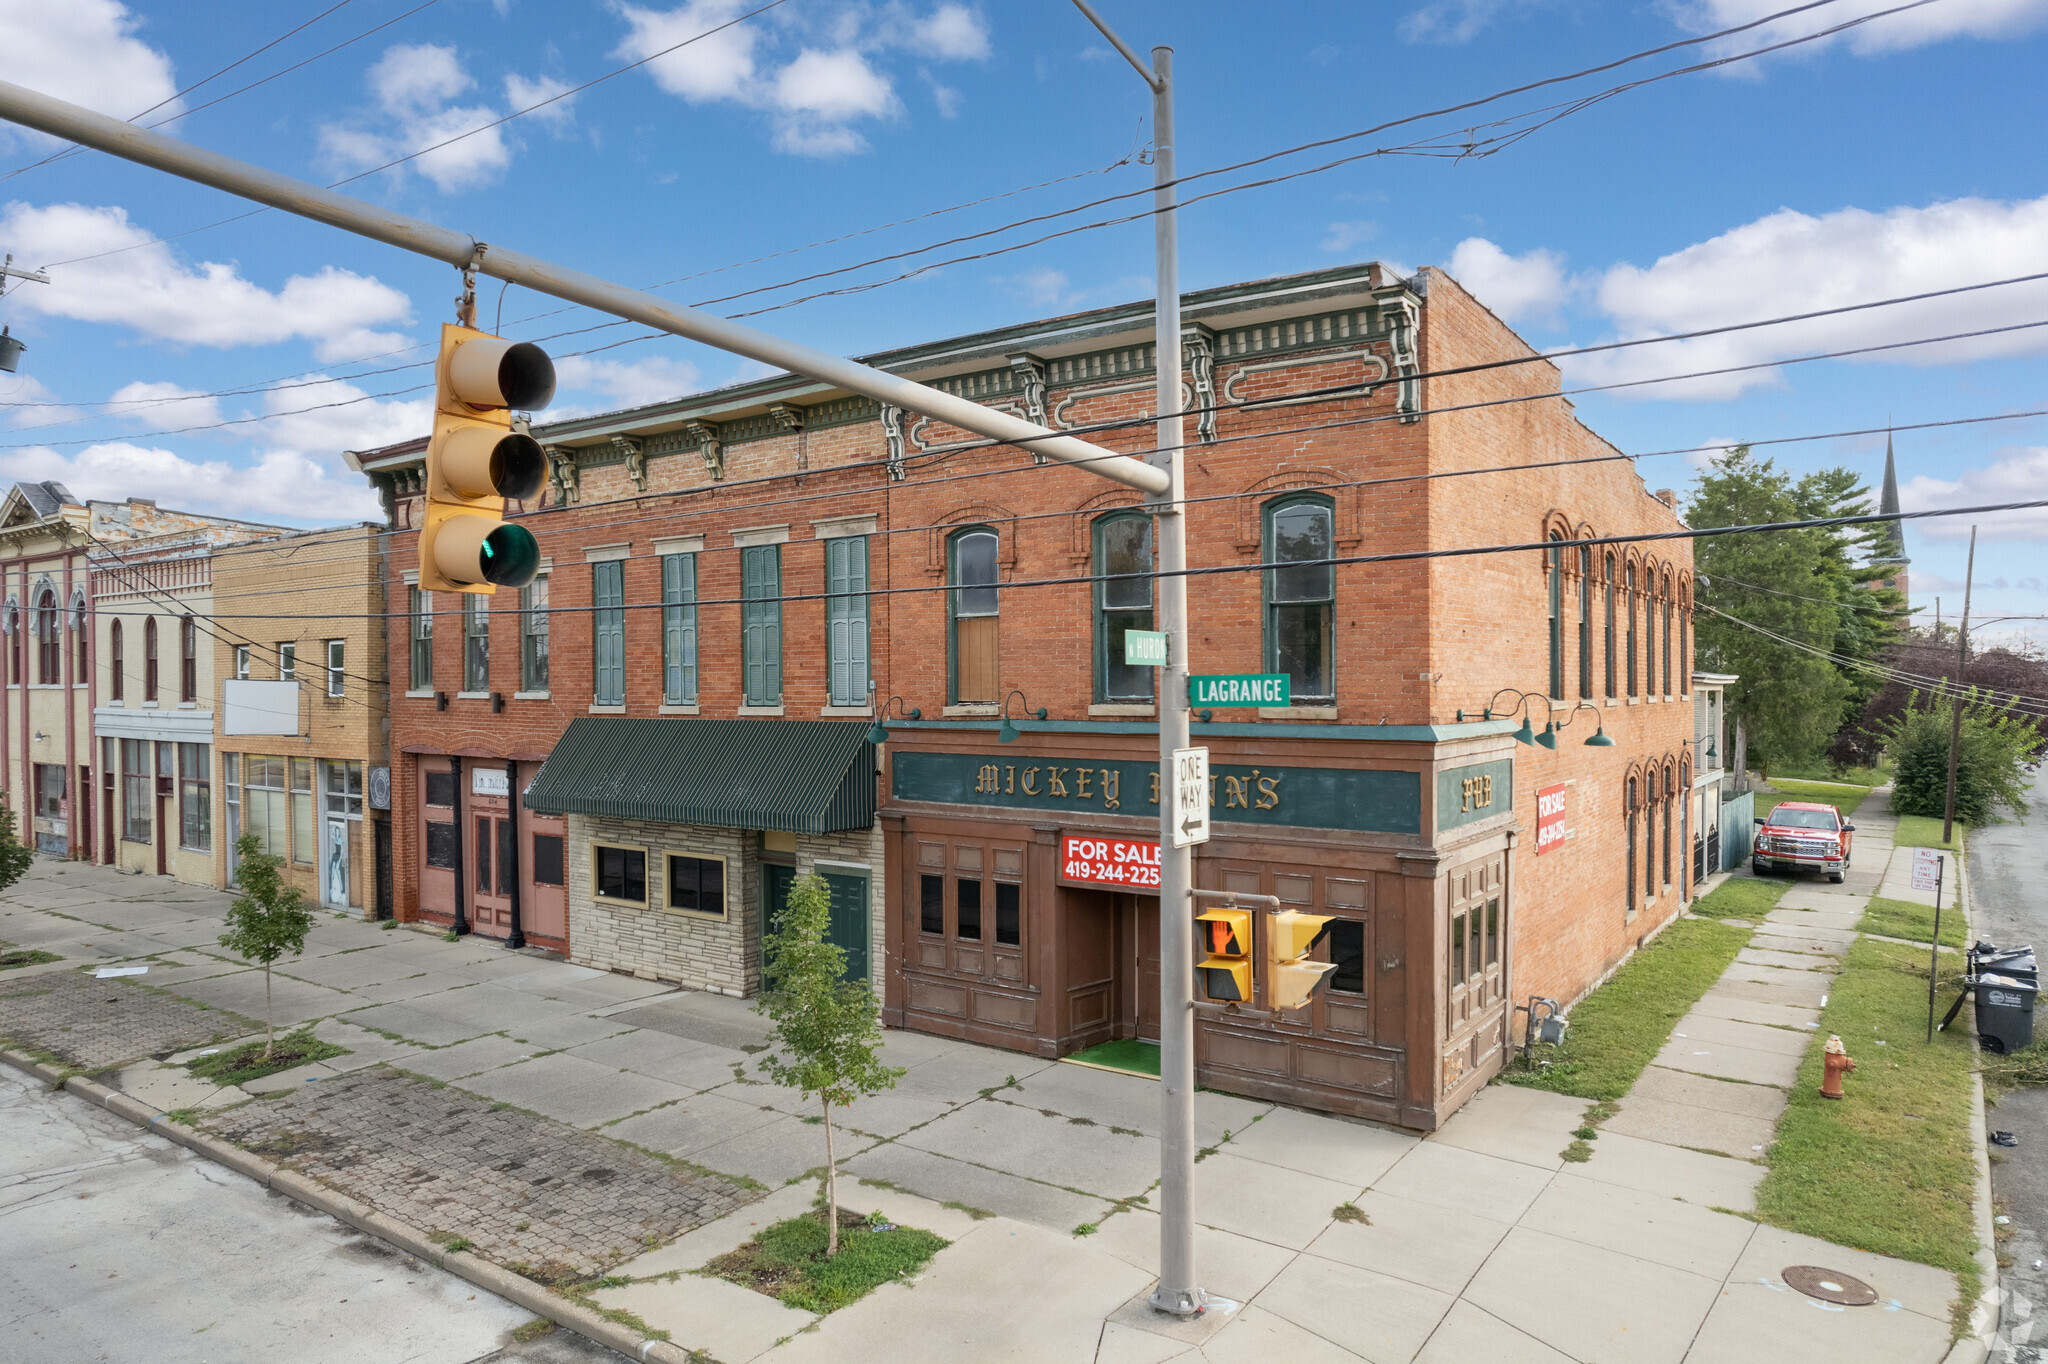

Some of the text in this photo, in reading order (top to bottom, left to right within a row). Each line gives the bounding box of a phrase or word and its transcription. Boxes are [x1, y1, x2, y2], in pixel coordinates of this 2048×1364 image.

[1129, 636, 1166, 659] N HURON
[1198, 679, 1283, 702] LAGRANGE
[1180, 756, 1201, 781] ONE
[975, 764, 1120, 809] MICKEY
[1180, 784, 1202, 810] WAY
[1461, 775, 1491, 812] PUB
[1539, 790, 1565, 818] FOR SALE
[1068, 839, 1161, 866] FOR SALE
[1921, 850, 1931, 858] NO
[1065, 860, 1161, 886] 419-244-225
